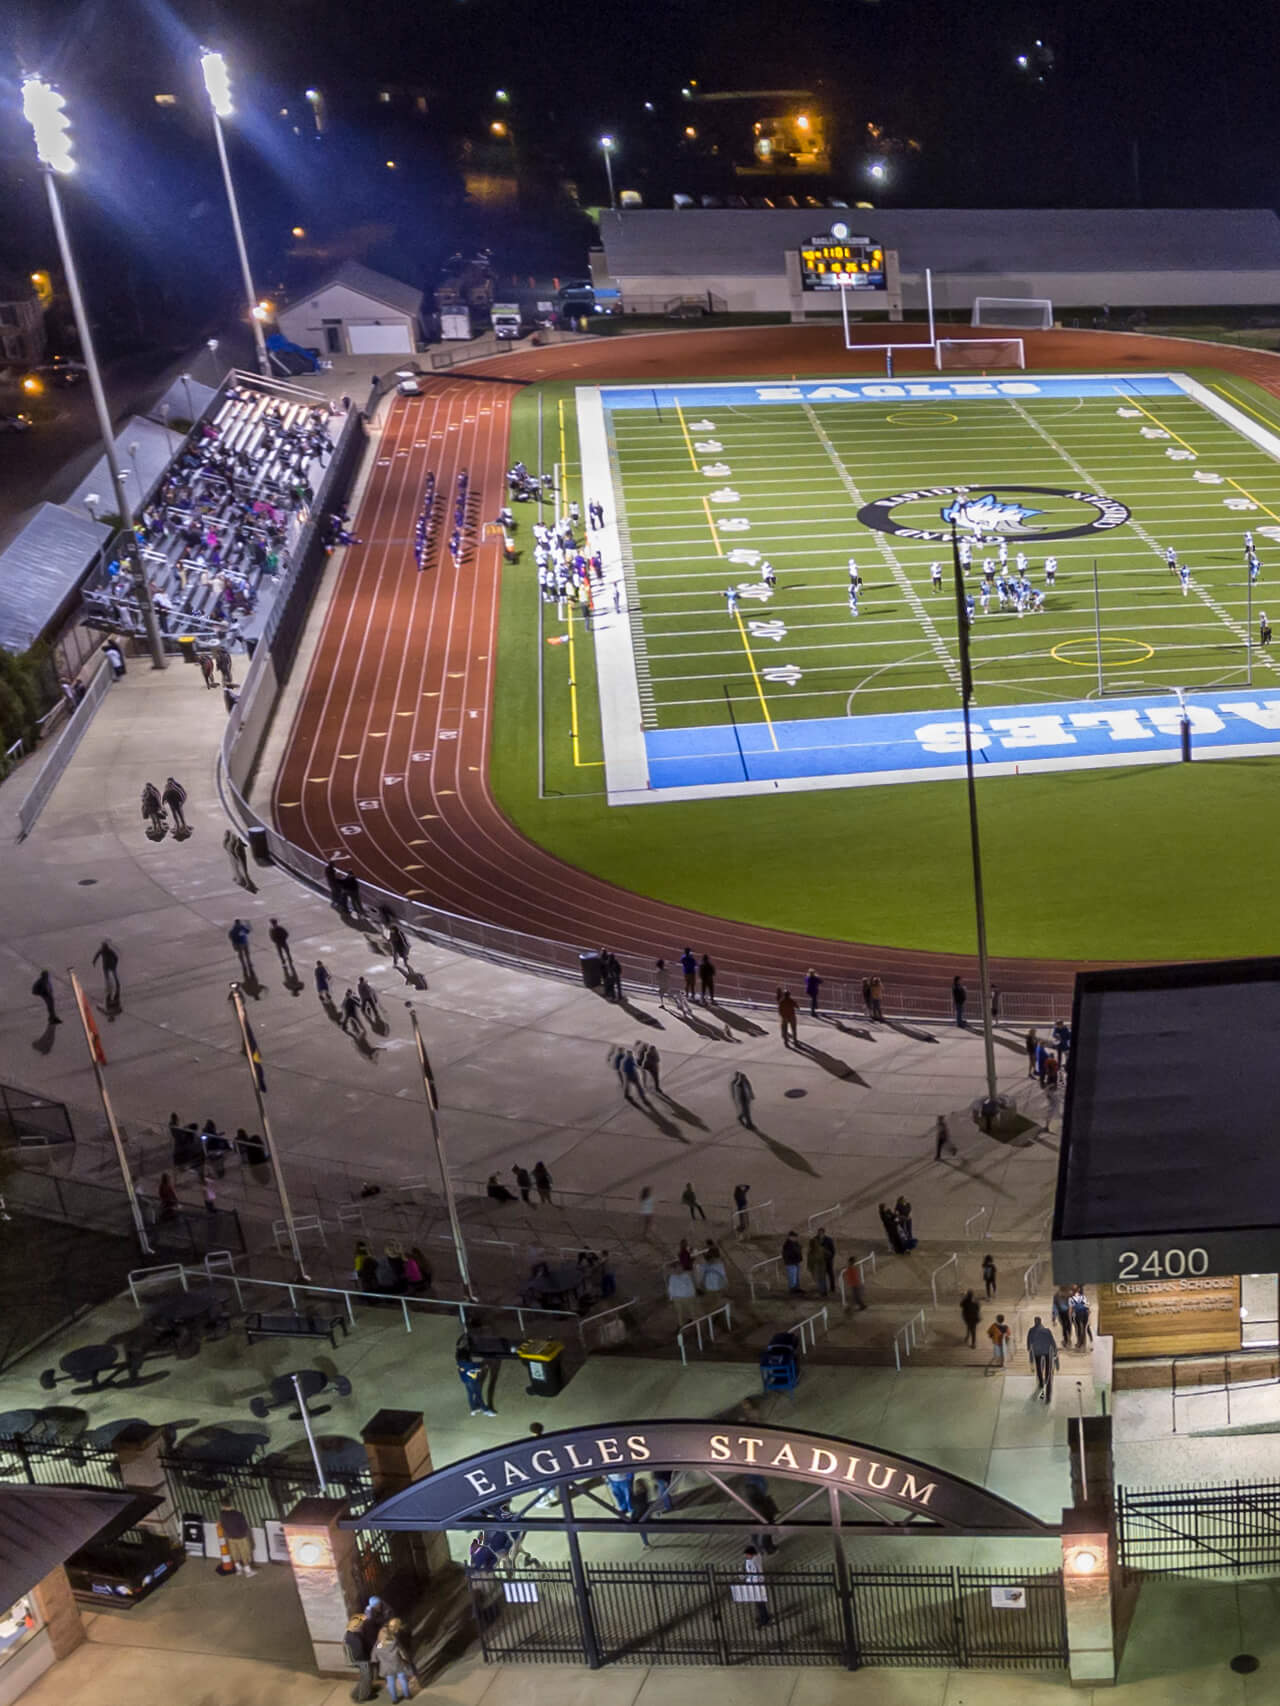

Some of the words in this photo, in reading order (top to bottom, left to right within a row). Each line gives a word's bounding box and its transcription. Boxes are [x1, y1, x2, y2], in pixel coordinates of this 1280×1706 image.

[755, 383, 1041, 400] EAGLES
[748, 619, 788, 639] 20
[762, 665, 802, 684] 10
[412, 752, 432, 762] 3
[358, 800, 380, 810] 5
[1118, 1248, 1209, 1279] 2400
[463, 1434, 651, 1496] EAGLES
[710, 1435, 938, 1506] STADIUM
